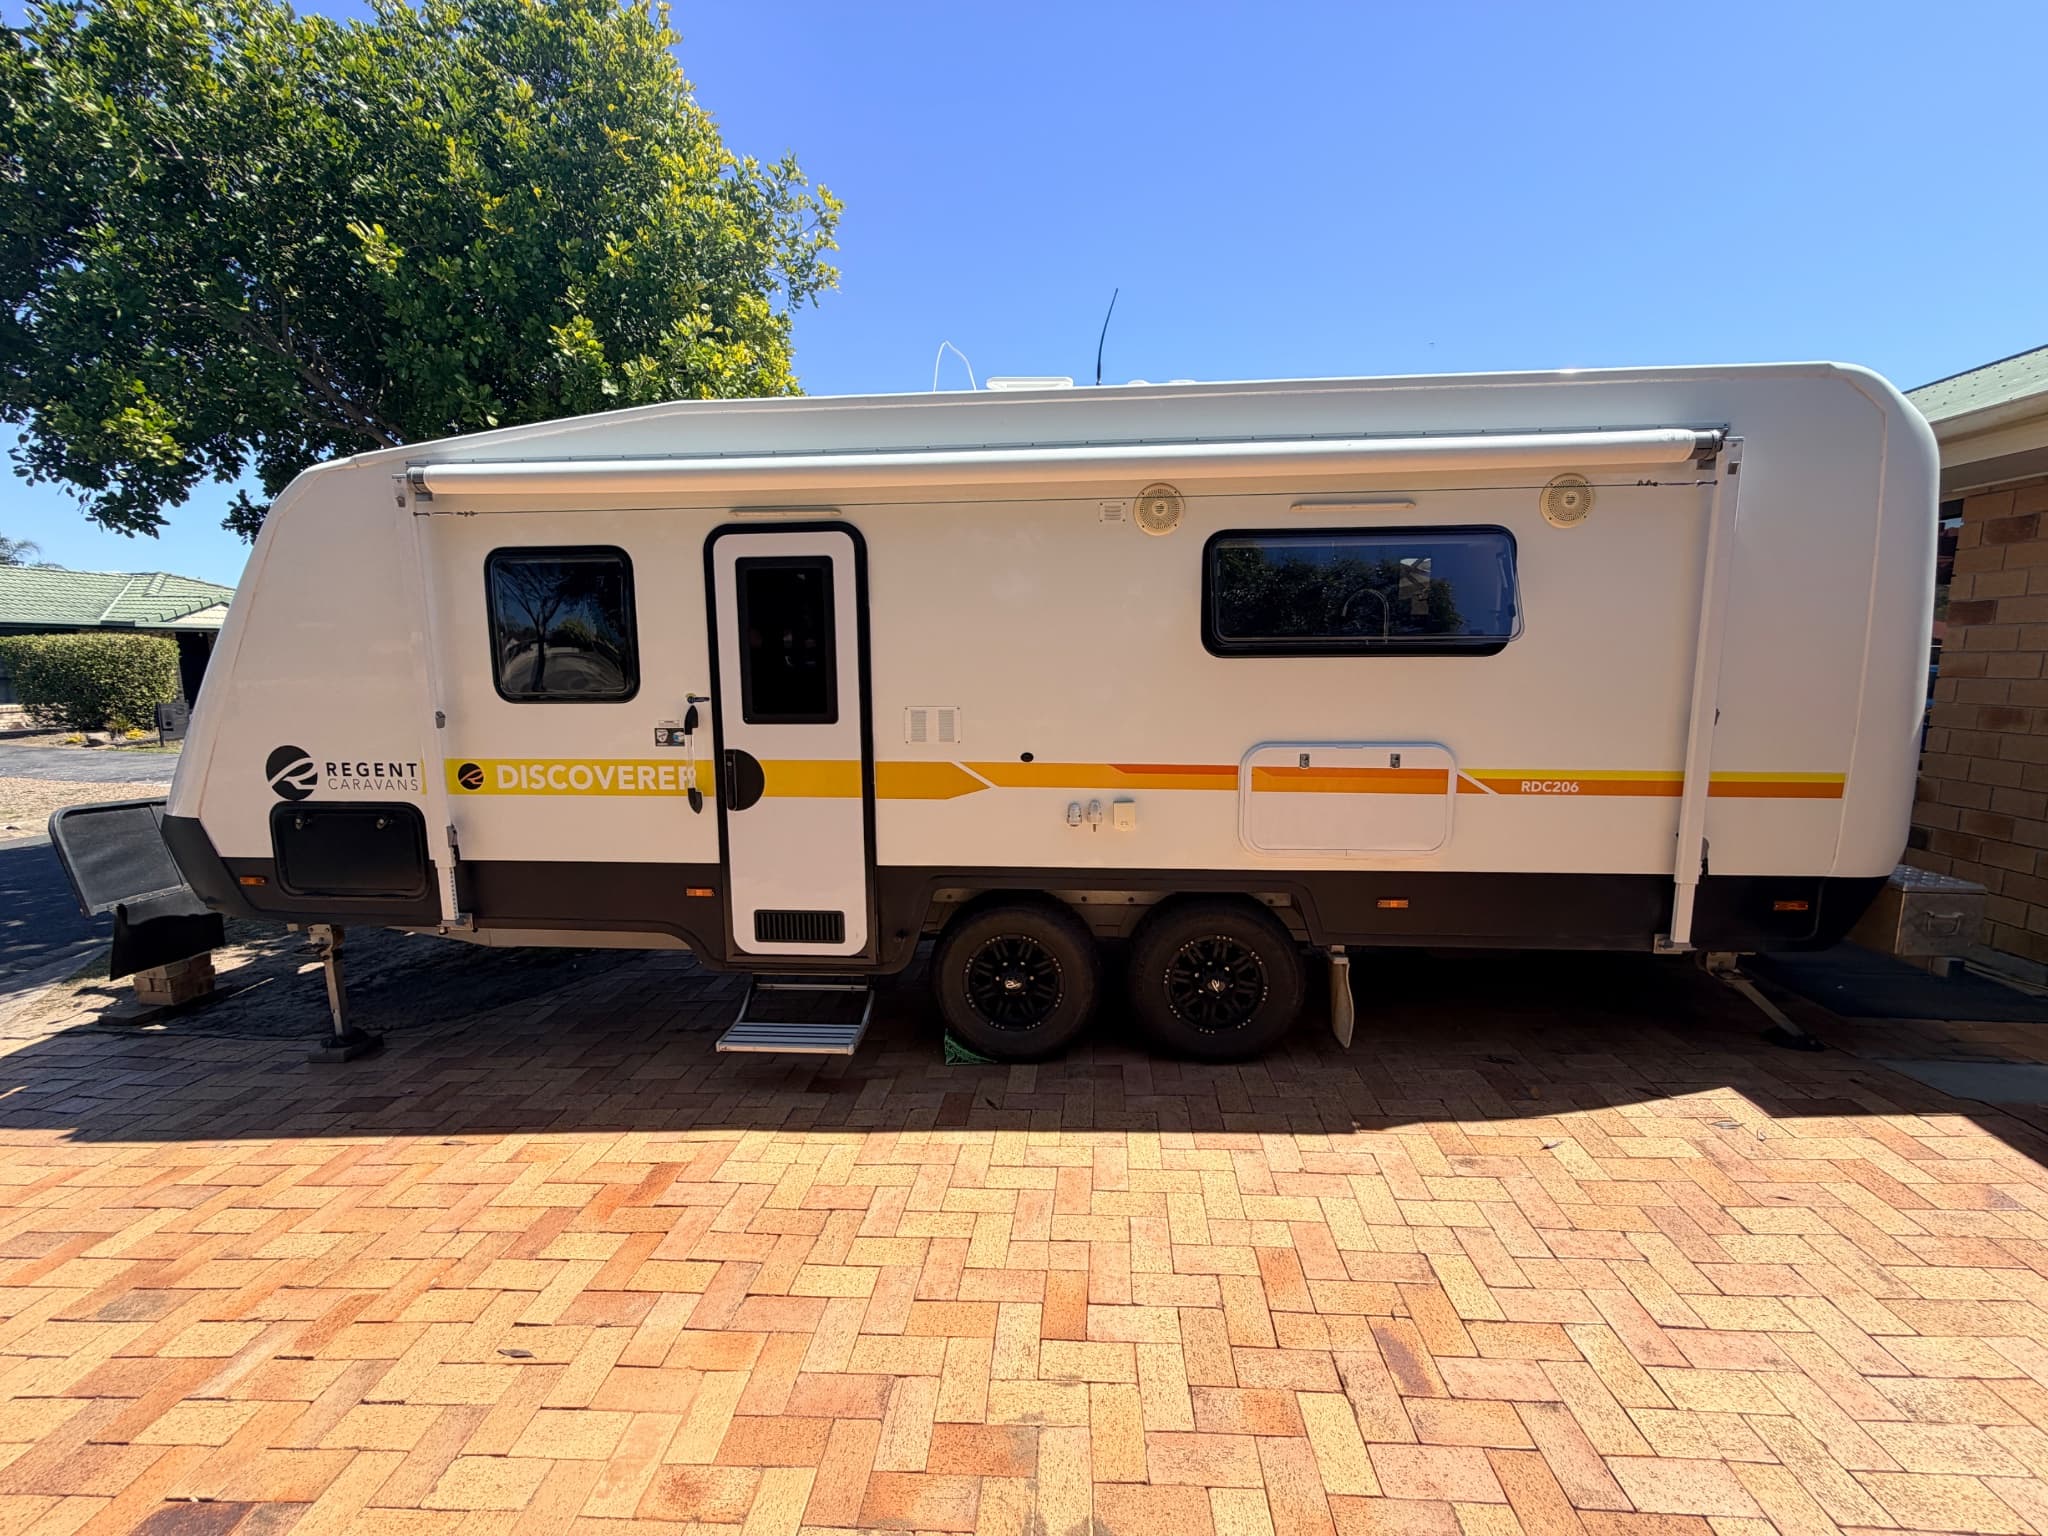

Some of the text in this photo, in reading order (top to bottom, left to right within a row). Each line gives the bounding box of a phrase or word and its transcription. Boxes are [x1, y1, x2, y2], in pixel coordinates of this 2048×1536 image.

[326, 762, 417, 777] REGENT
[328, 778, 419, 791] CARAVANS
[1521, 780, 1580, 793] RDC206
